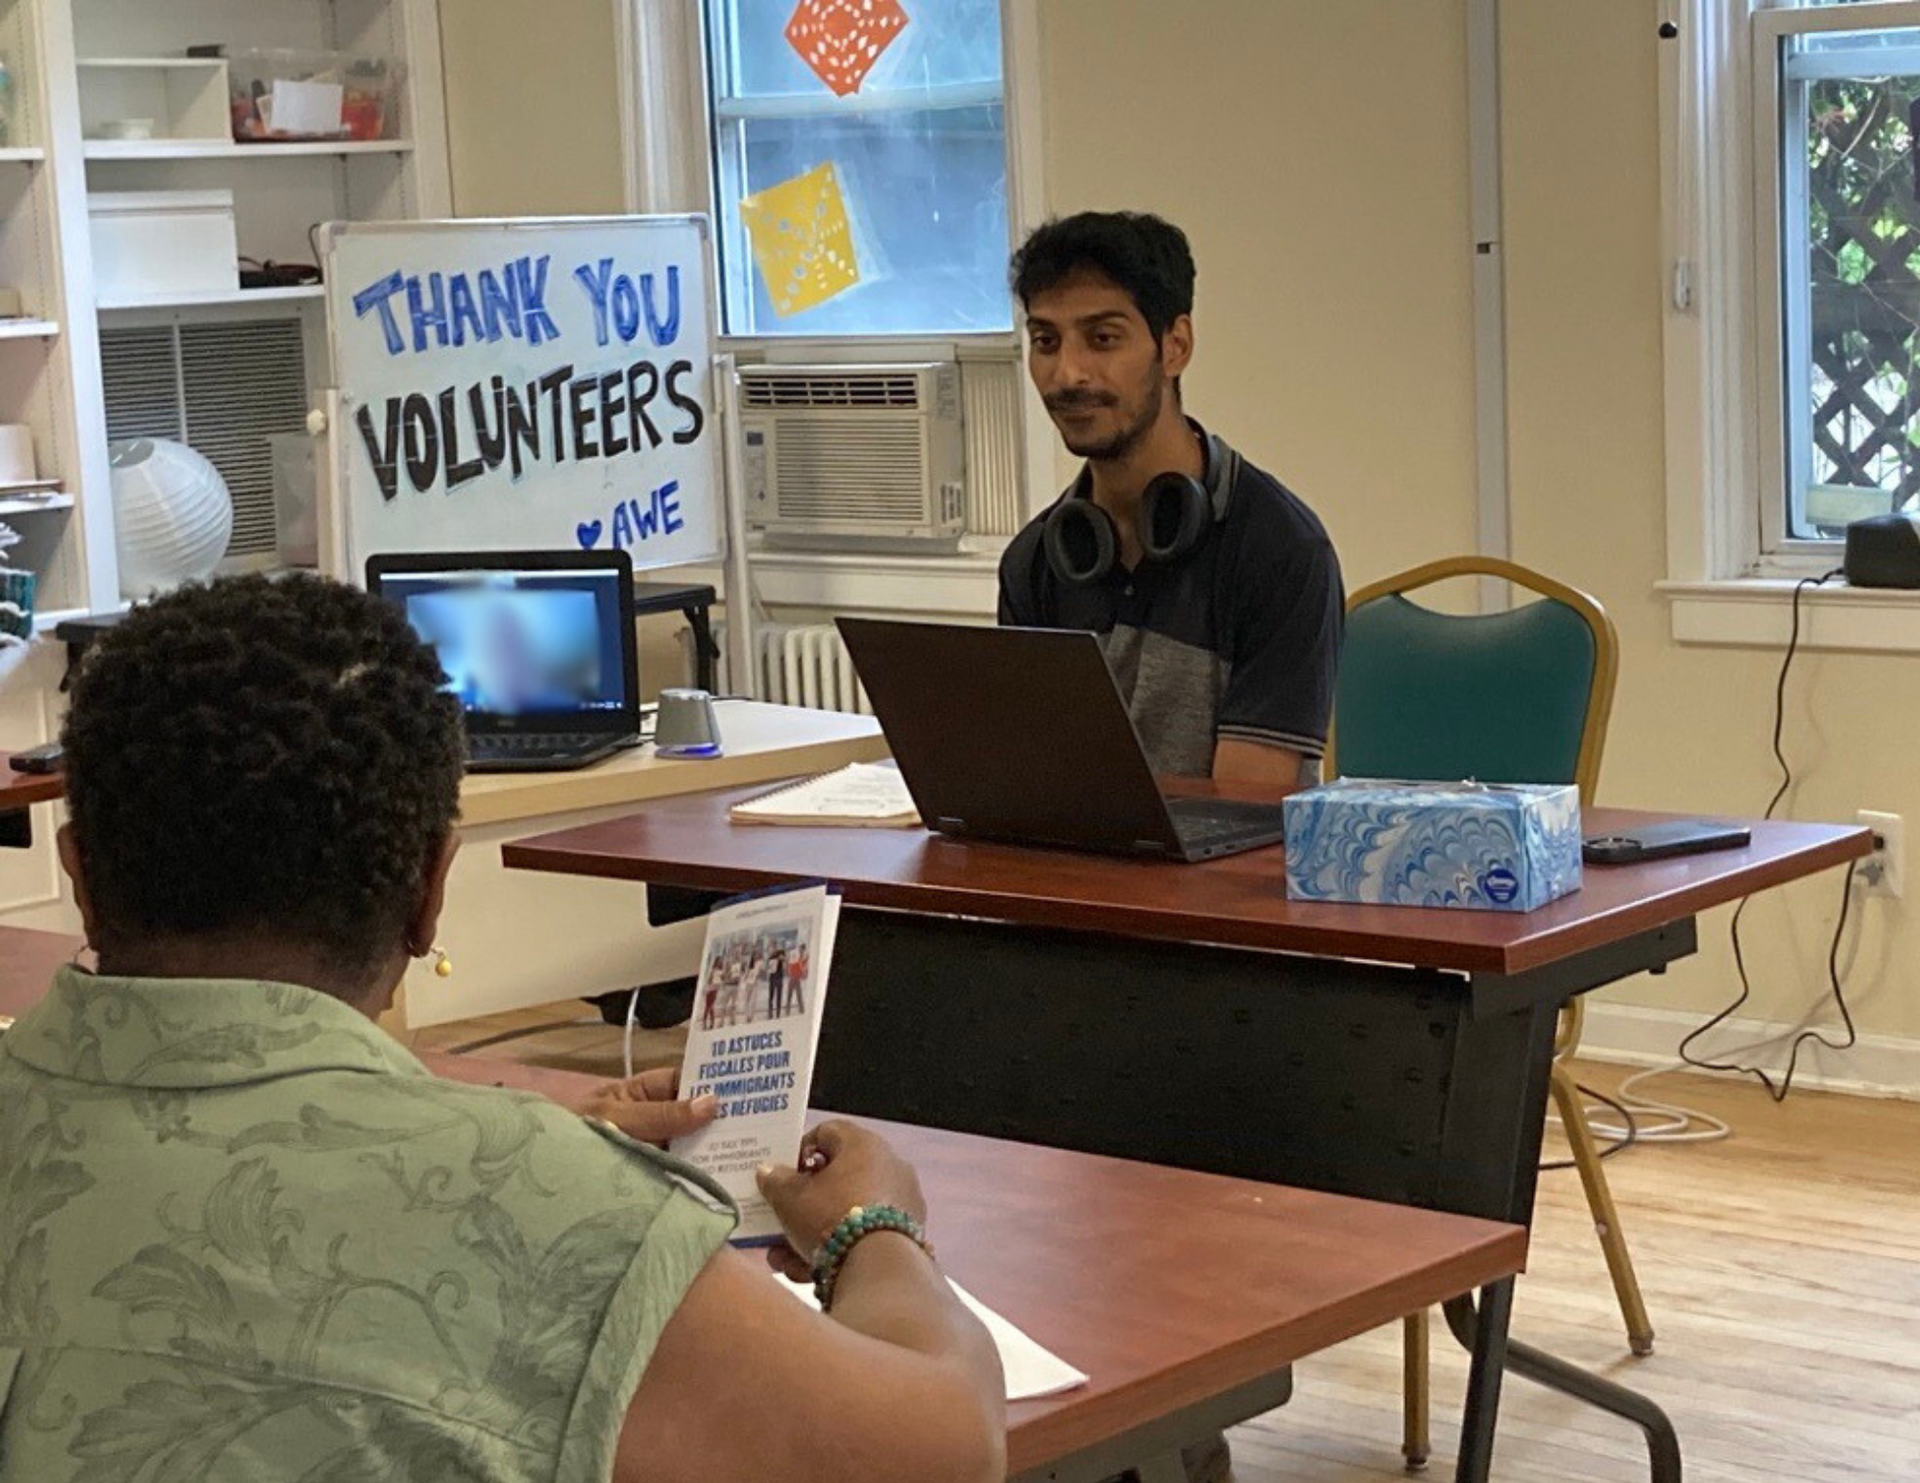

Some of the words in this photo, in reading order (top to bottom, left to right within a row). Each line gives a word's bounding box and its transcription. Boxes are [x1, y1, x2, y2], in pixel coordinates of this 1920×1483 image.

[353, 255, 560, 355] THANK
[574, 257, 679, 347] YOU
[355, 360, 703, 501] VOLUNTEERS
[612, 480, 684, 549] AWE
[699, 1056, 754, 1079] FISCALES
[757, 1051, 790, 1071] POUR
[711, 1040, 727, 1057] 10
[728, 1031, 782, 1054] ASTUCES
[714, 1072, 795, 1096] IMMIGRANTS
